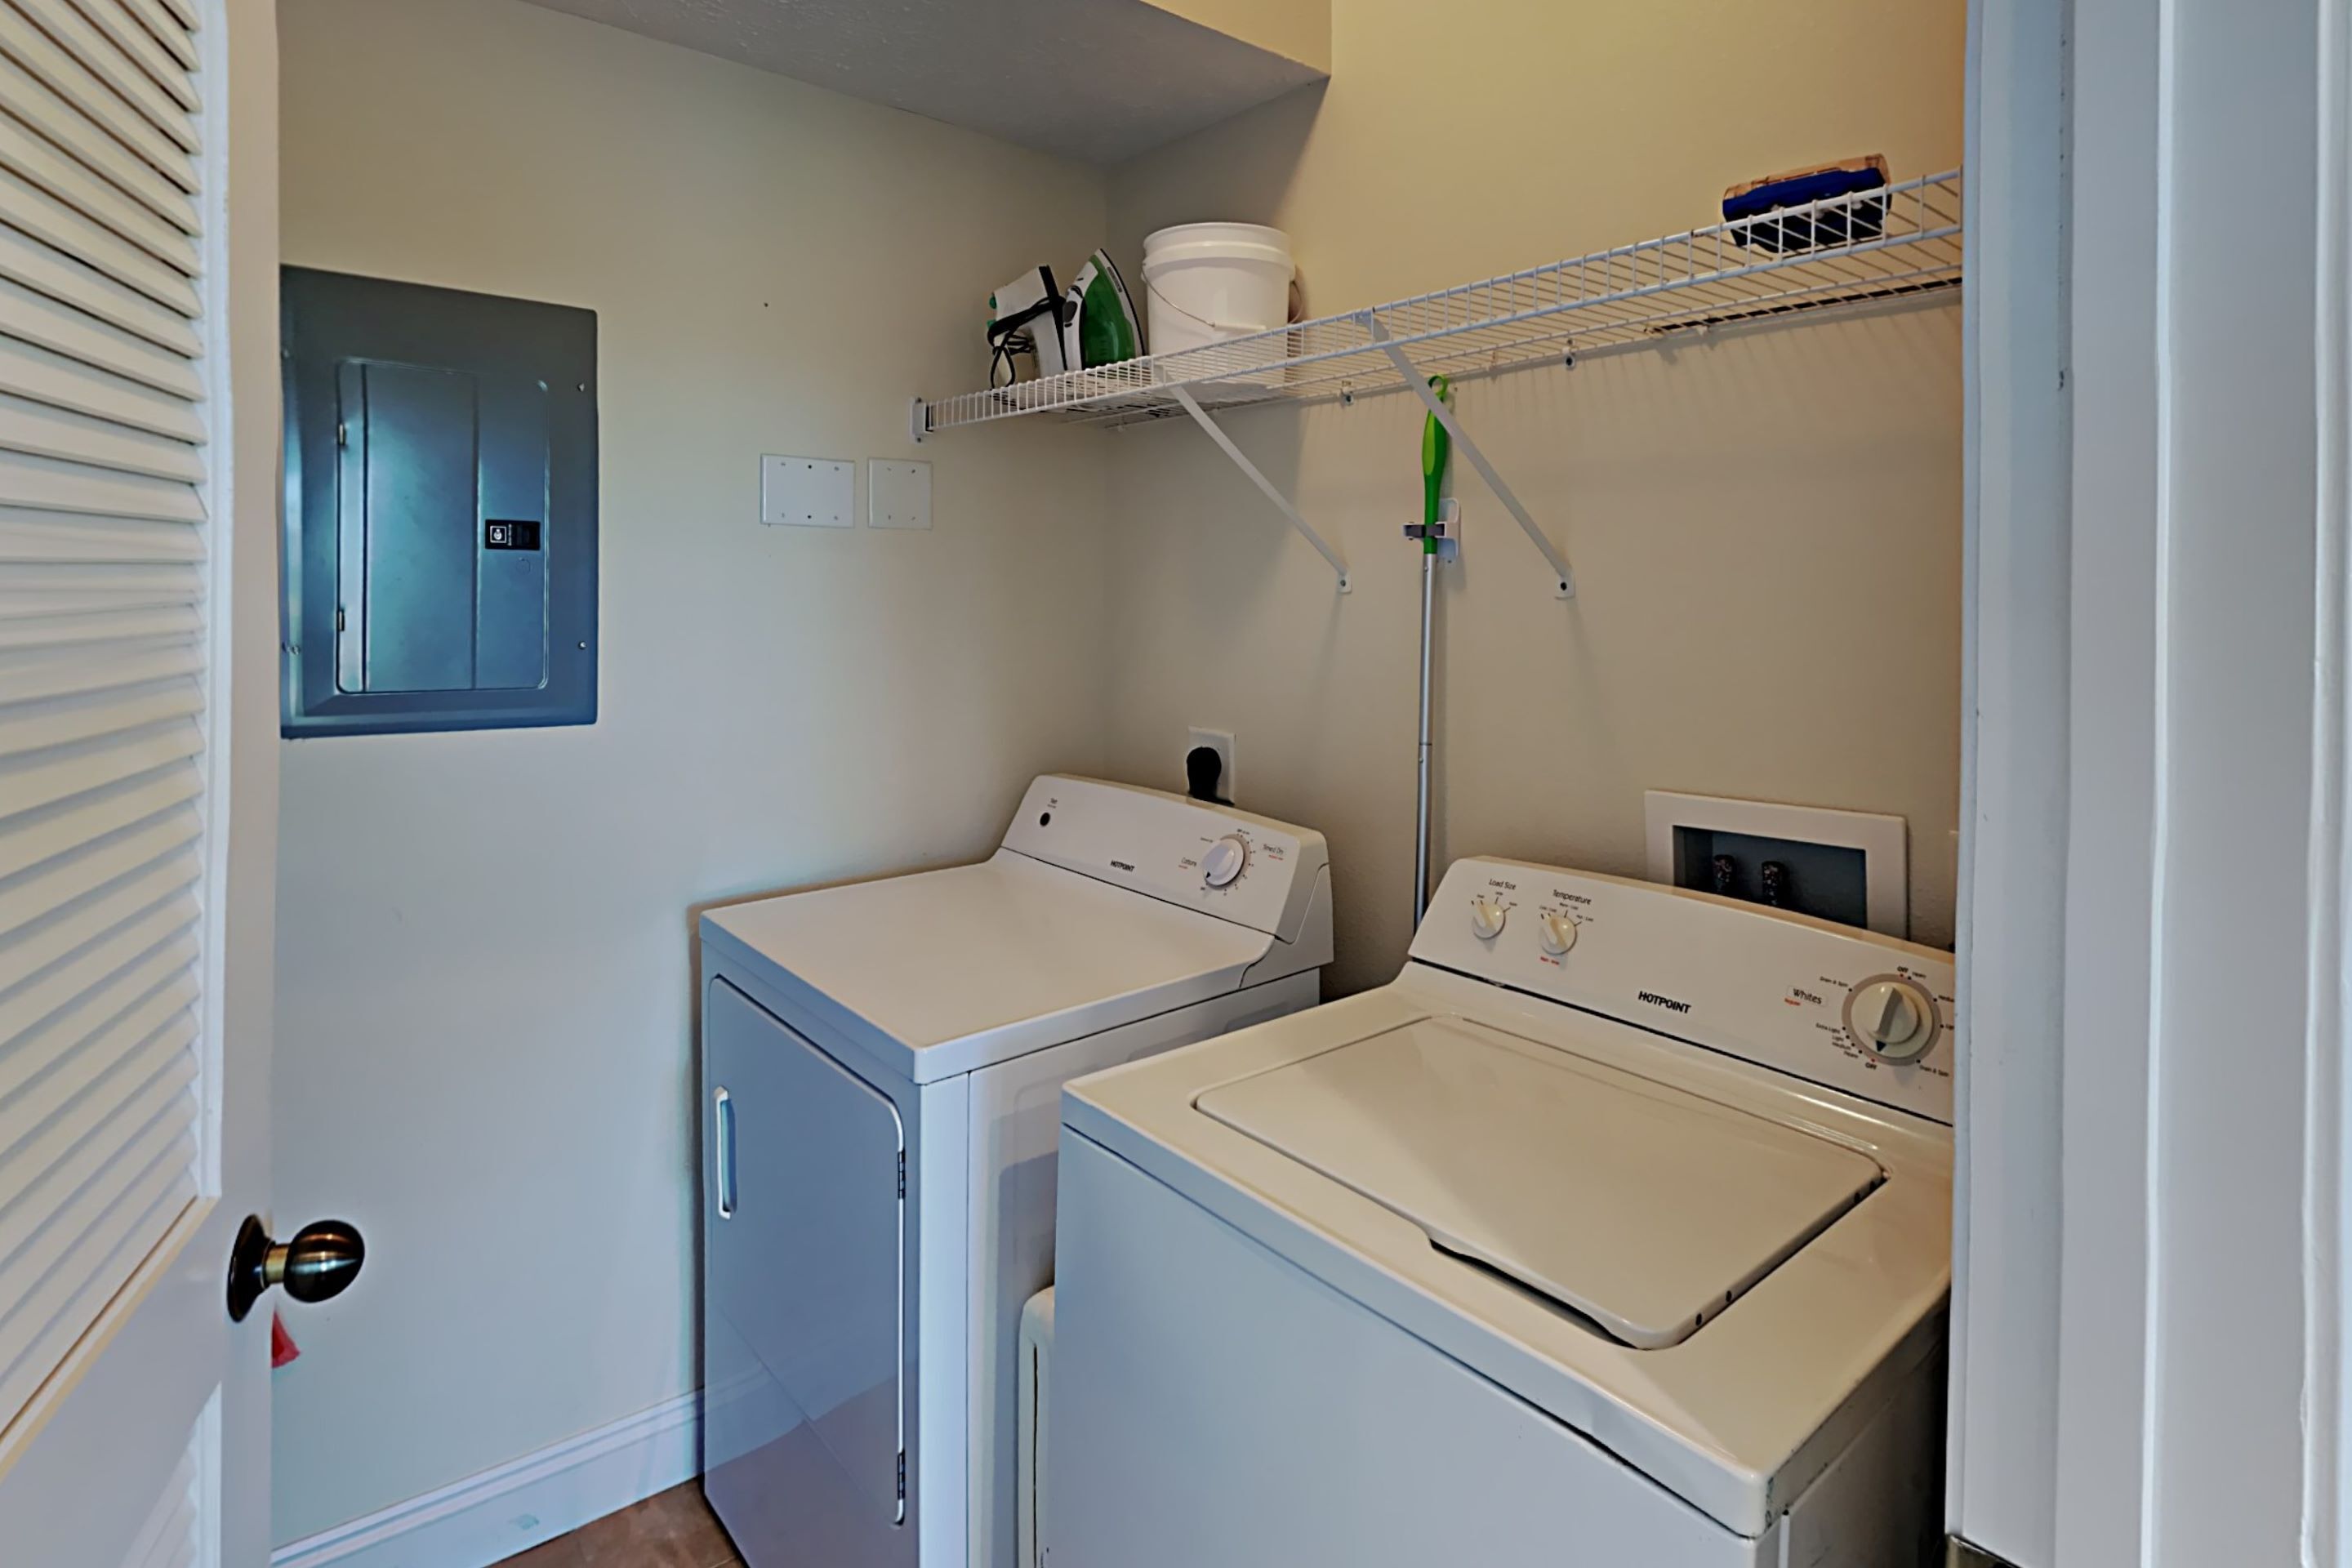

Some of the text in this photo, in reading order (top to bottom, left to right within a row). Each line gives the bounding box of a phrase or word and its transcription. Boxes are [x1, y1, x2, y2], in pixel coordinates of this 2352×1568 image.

[1111, 860, 1135, 872] HOTPOINT
[1489, 878, 1516, 890] Load Size
[1553, 889, 1592, 905] Temperature
[1638, 990, 1692, 1014] HOTPOINT
[1793, 987, 1822, 1004] Whites
